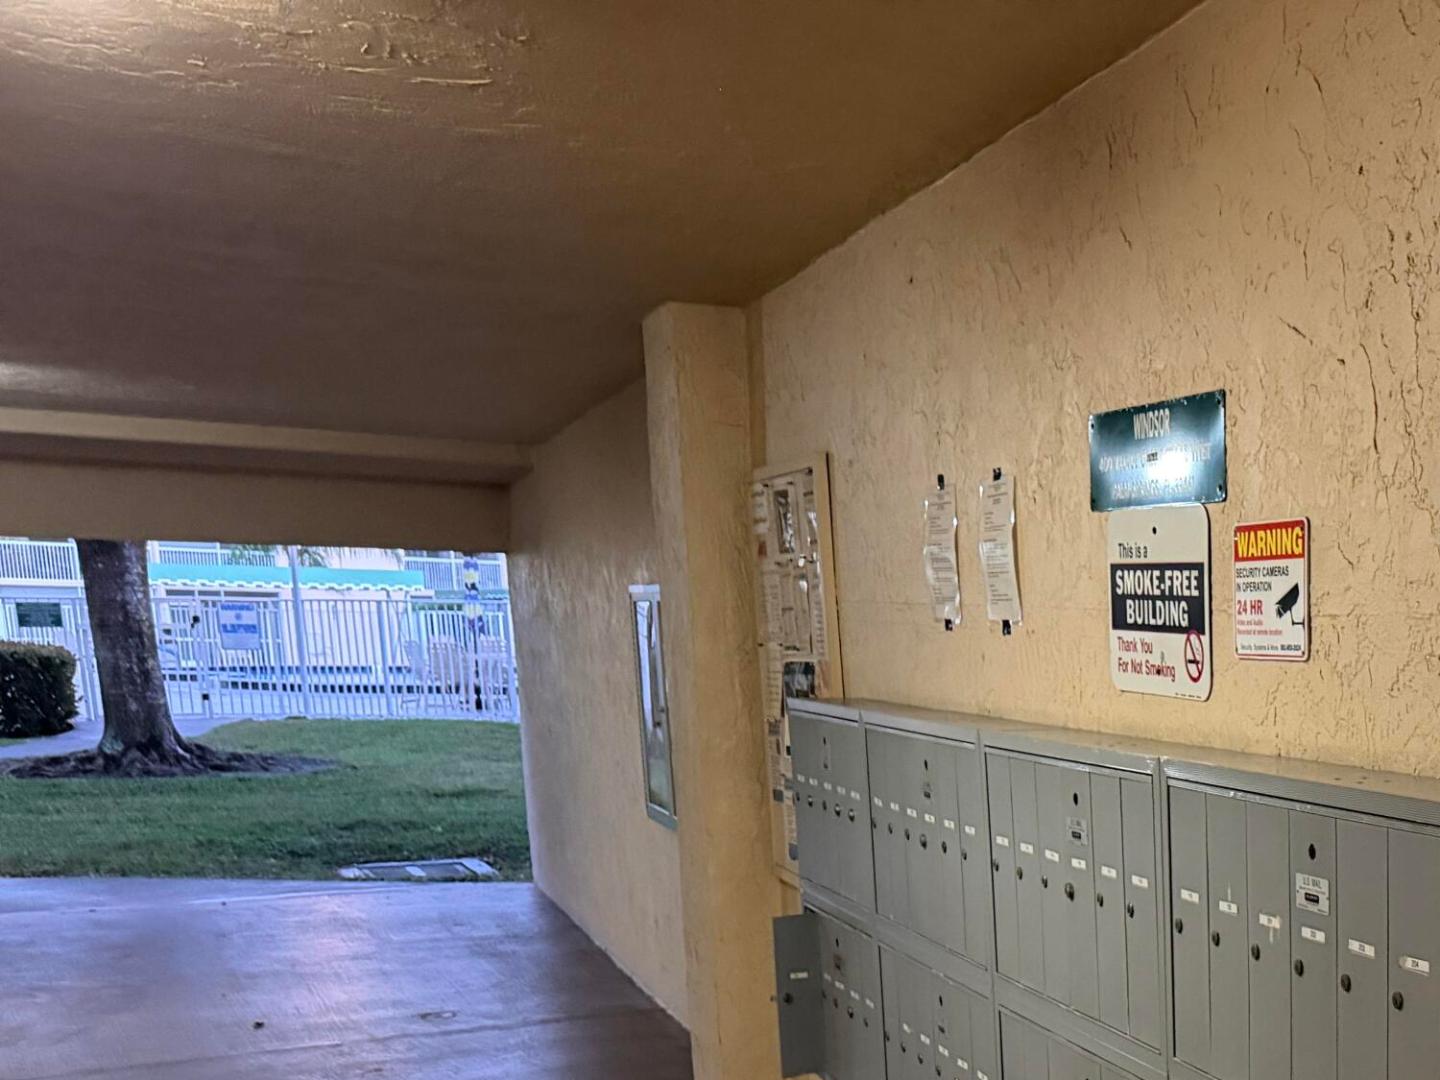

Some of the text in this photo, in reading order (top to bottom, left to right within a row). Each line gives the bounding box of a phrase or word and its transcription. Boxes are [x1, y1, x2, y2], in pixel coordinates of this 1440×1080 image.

[1133, 408, 1170, 440] WINDSOR
[1118, 543, 1133, 559] This
[1135, 542, 1144, 558] is
[1237, 527, 1303, 558] WARNING
[1236, 565, 1289, 578] SECURITY CAMERAS
[1115, 569, 1200, 597] SMOKE-FREE
[1242, 581, 1272, 592] OPERATION
[1126, 599, 1189, 627] BUILDING
[1237, 600, 1263, 615] 24 HR
[1117, 636, 1153, 654] Thank You
[1117, 657, 1176, 683] For Not Smoking
